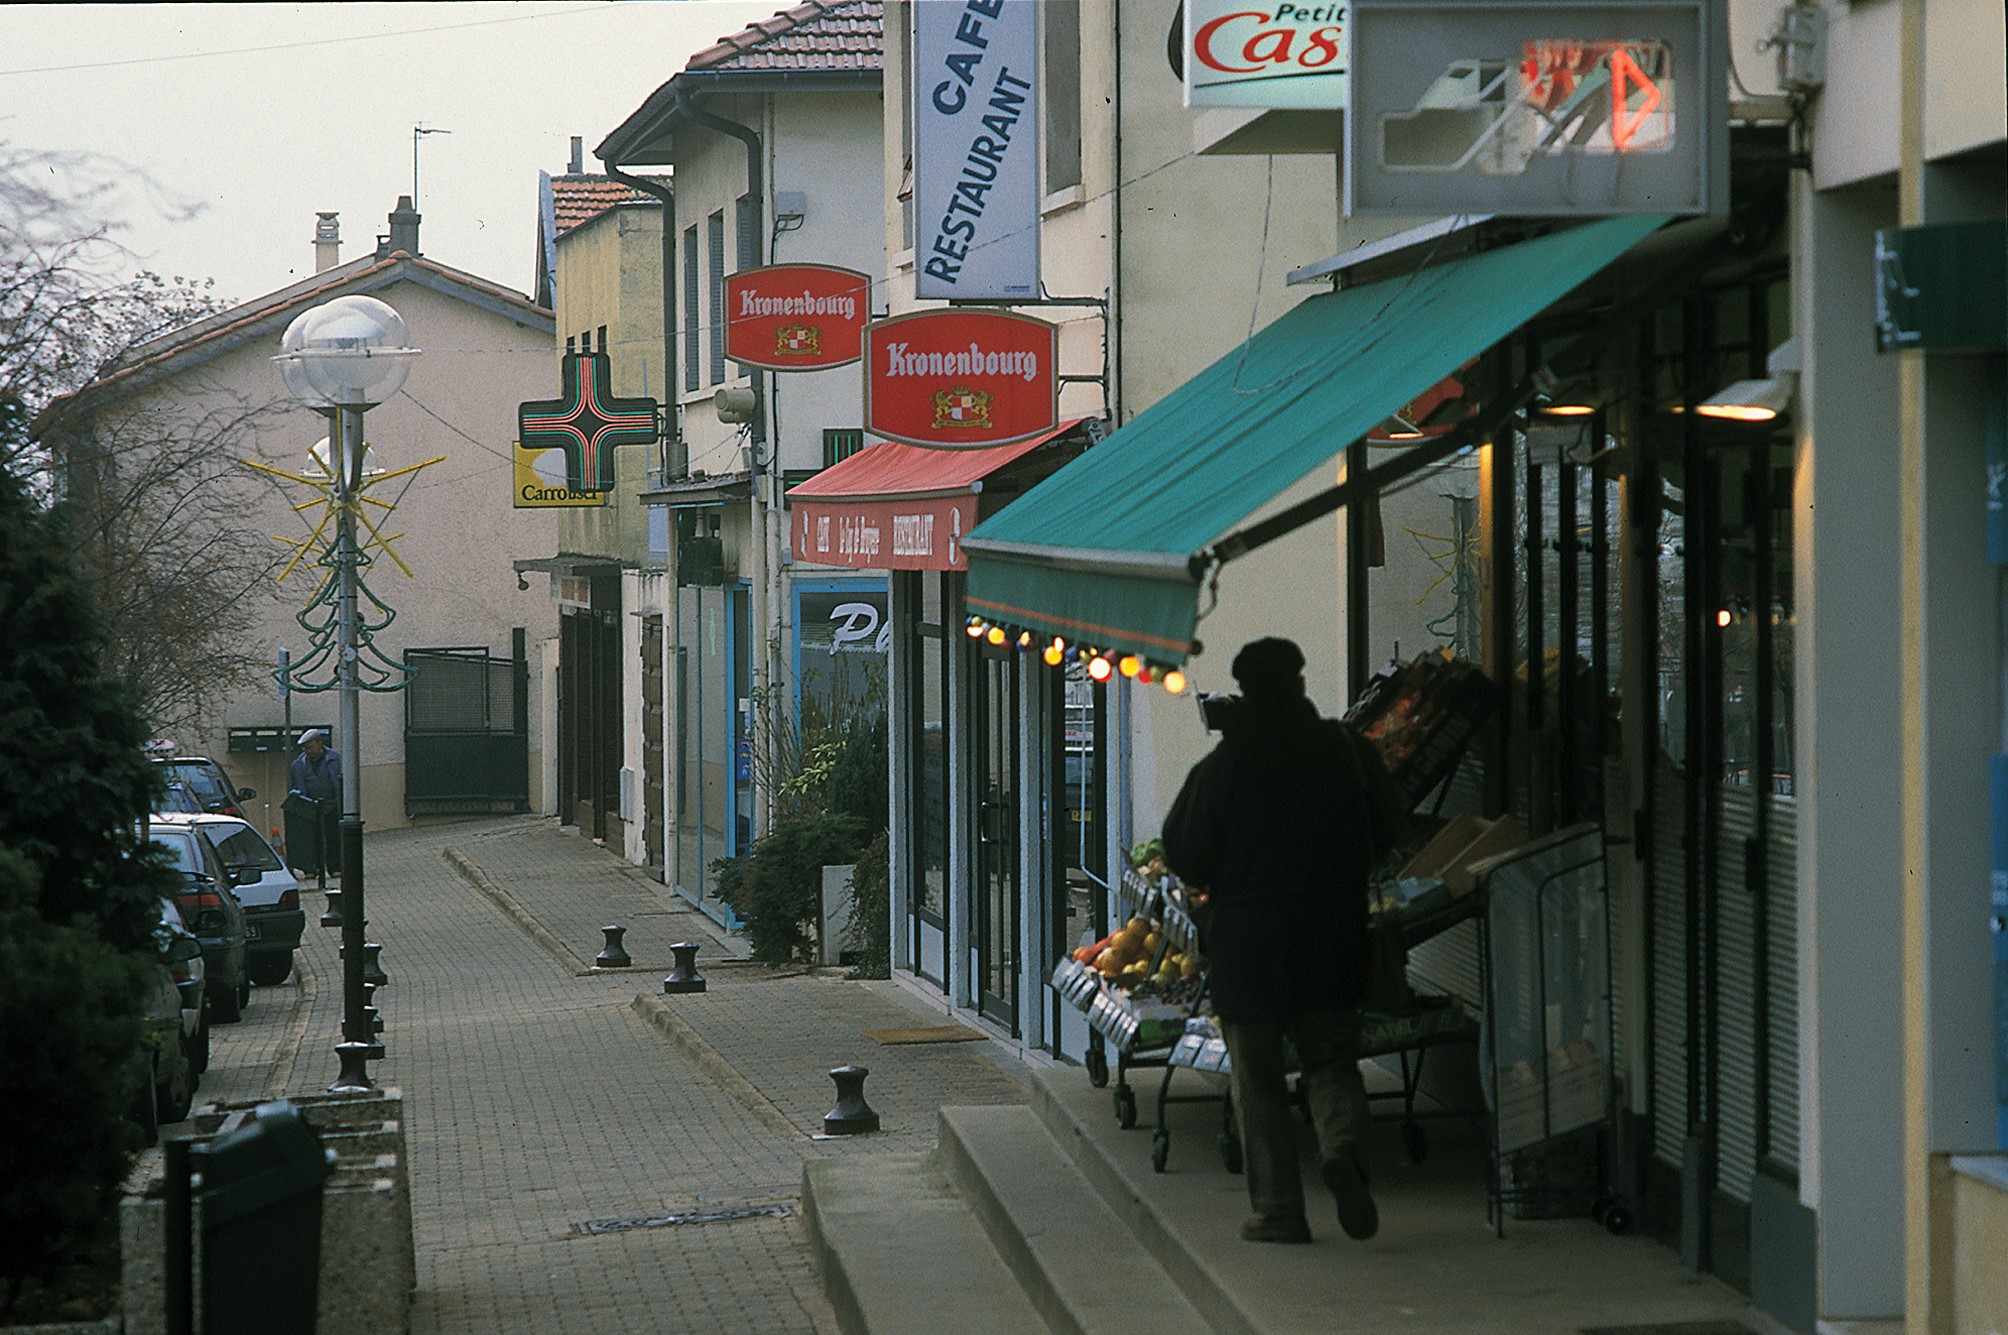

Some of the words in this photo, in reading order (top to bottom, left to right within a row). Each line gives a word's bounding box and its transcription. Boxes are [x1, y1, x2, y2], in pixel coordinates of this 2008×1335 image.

[1275, 4, 1346, 22] Petit
[1194, 11, 1347, 73] Cas
[924, 66, 1031, 285] RESTAURANT
[740, 290, 855, 320] Kronenbourg
[886, 342, 1037, 382] Kronenbourg
